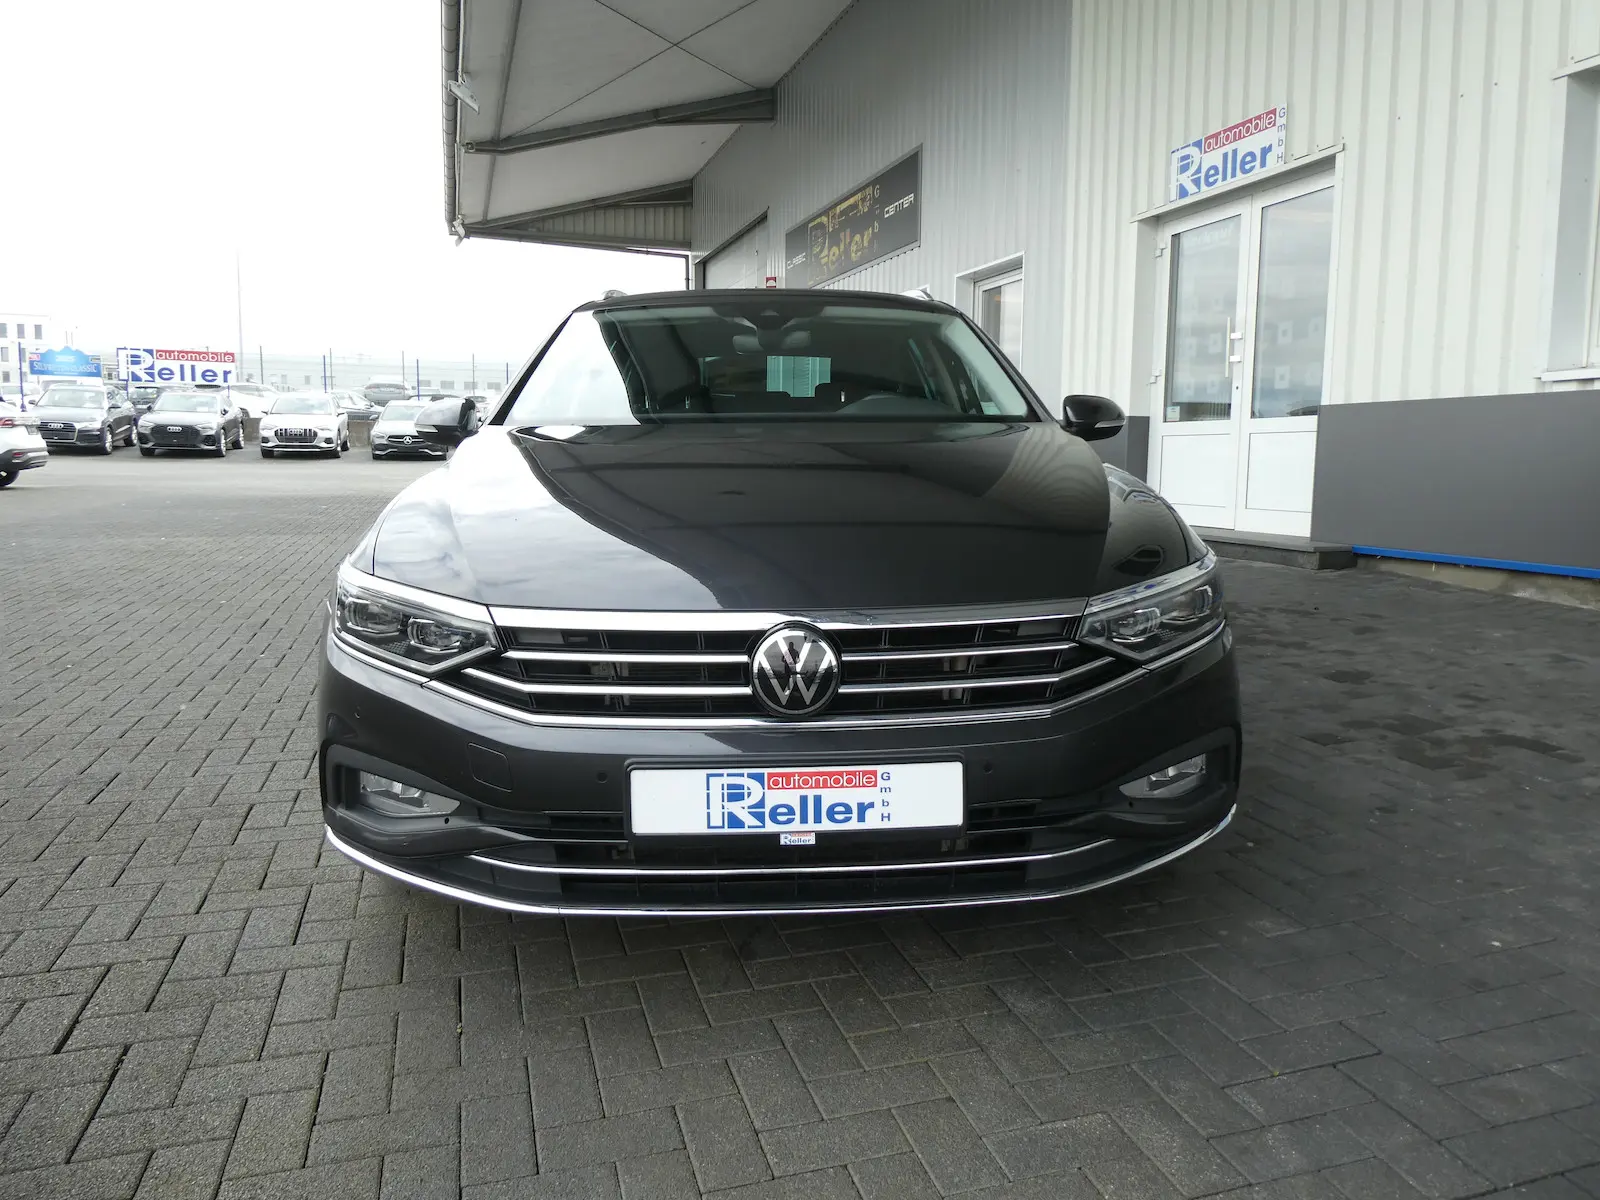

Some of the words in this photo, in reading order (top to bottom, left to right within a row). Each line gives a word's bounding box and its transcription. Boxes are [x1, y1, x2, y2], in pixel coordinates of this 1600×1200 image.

[1204, 112, 1275, 152] automobile
[1276, 107, 1286, 163] GmbH
[1169, 139, 1272, 203] Reller
[883, 193, 914, 218] CENTER
[116, 348, 232, 383] Reller
[156, 351, 233, 362] automobile
[769, 771, 875, 789] automobile
[880, 771, 892, 822] GmbH
[706, 772, 875, 829] Reller
